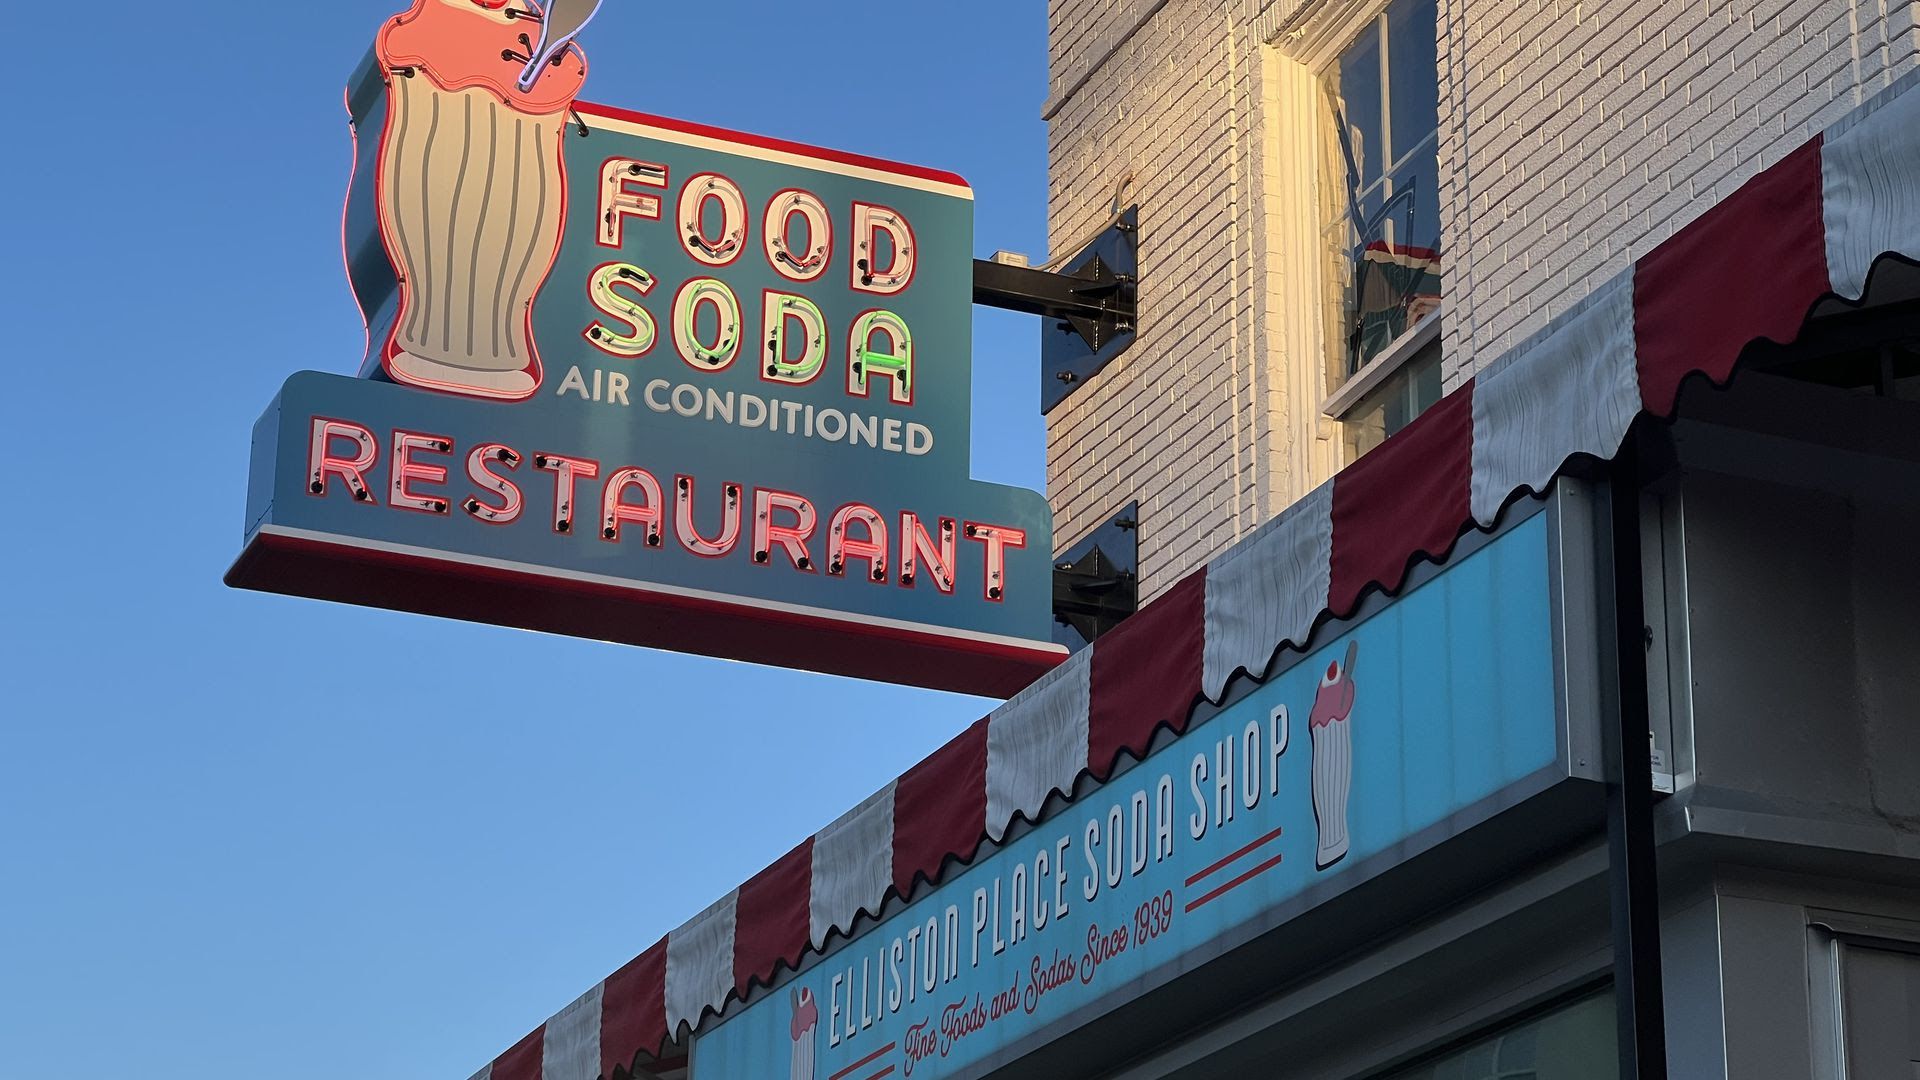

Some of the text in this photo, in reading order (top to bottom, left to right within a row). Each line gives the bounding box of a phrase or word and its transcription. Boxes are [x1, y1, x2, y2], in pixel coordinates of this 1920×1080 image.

[596, 156, 917, 295] FOOD
[556, 365, 934, 456] AIR CONDITIONED
[581, 261, 914, 406] SODA
[305, 416, 1026, 602] RESTAURANT
[830, 703, 1290, 1049] ELLISTON PLACE SODA SHOP
[904, 889, 1173, 1077] Fine Foods and Sodas Since 1939
